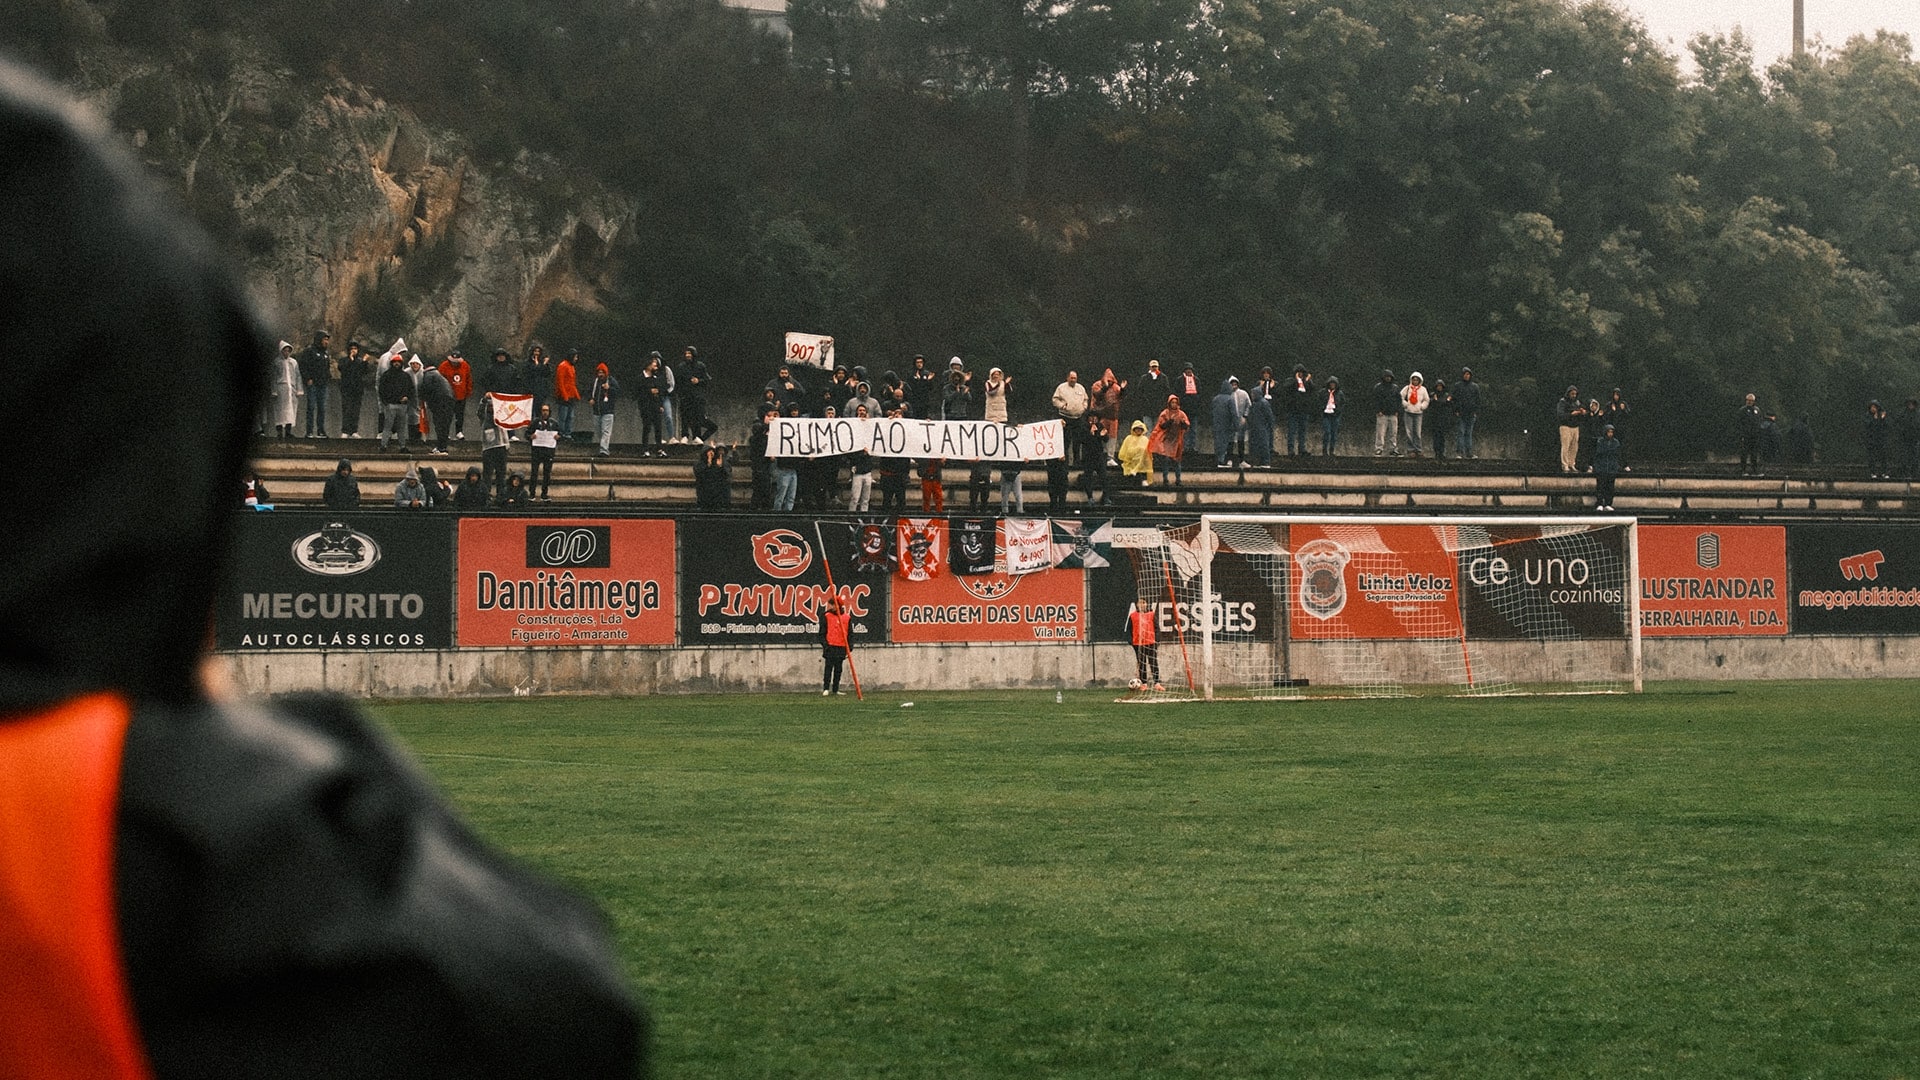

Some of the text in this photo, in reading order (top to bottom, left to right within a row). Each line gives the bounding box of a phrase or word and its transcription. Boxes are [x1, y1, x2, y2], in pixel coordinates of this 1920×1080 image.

[786, 342, 815, 362] 1907
[780, 421, 854, 455] RUMO
[871, 421, 905, 453] AO
[1032, 424, 1056, 440] MV
[1035, 442, 1055, 456] 03
[1470, 557, 1589, 585] ce uno
[1358, 573, 1453, 591] Linha Veloz
[477, 570, 660, 619] Danitâmega
[1550, 582, 1621, 603] cozinhas
[243, 593, 424, 619] MECURITO
[899, 605, 1077, 624] GARAGEM DAS LAPAS
[1124, 594, 1256, 632] ESSÕES
[517, 613, 623, 627] Construções, Lda
[726, 623, 755, 633] Pintura
[767, 622, 806, 635] Máquinas
[1639, 609, 1784, 629] SERRALHARIA, LDA.
[242, 632, 425, 646] AUTOCLÁSSICOS
[511, 629, 561, 643] Figueiró
[571, 629, 629, 640] Amarante
[1034, 627, 1053, 638] Vila
